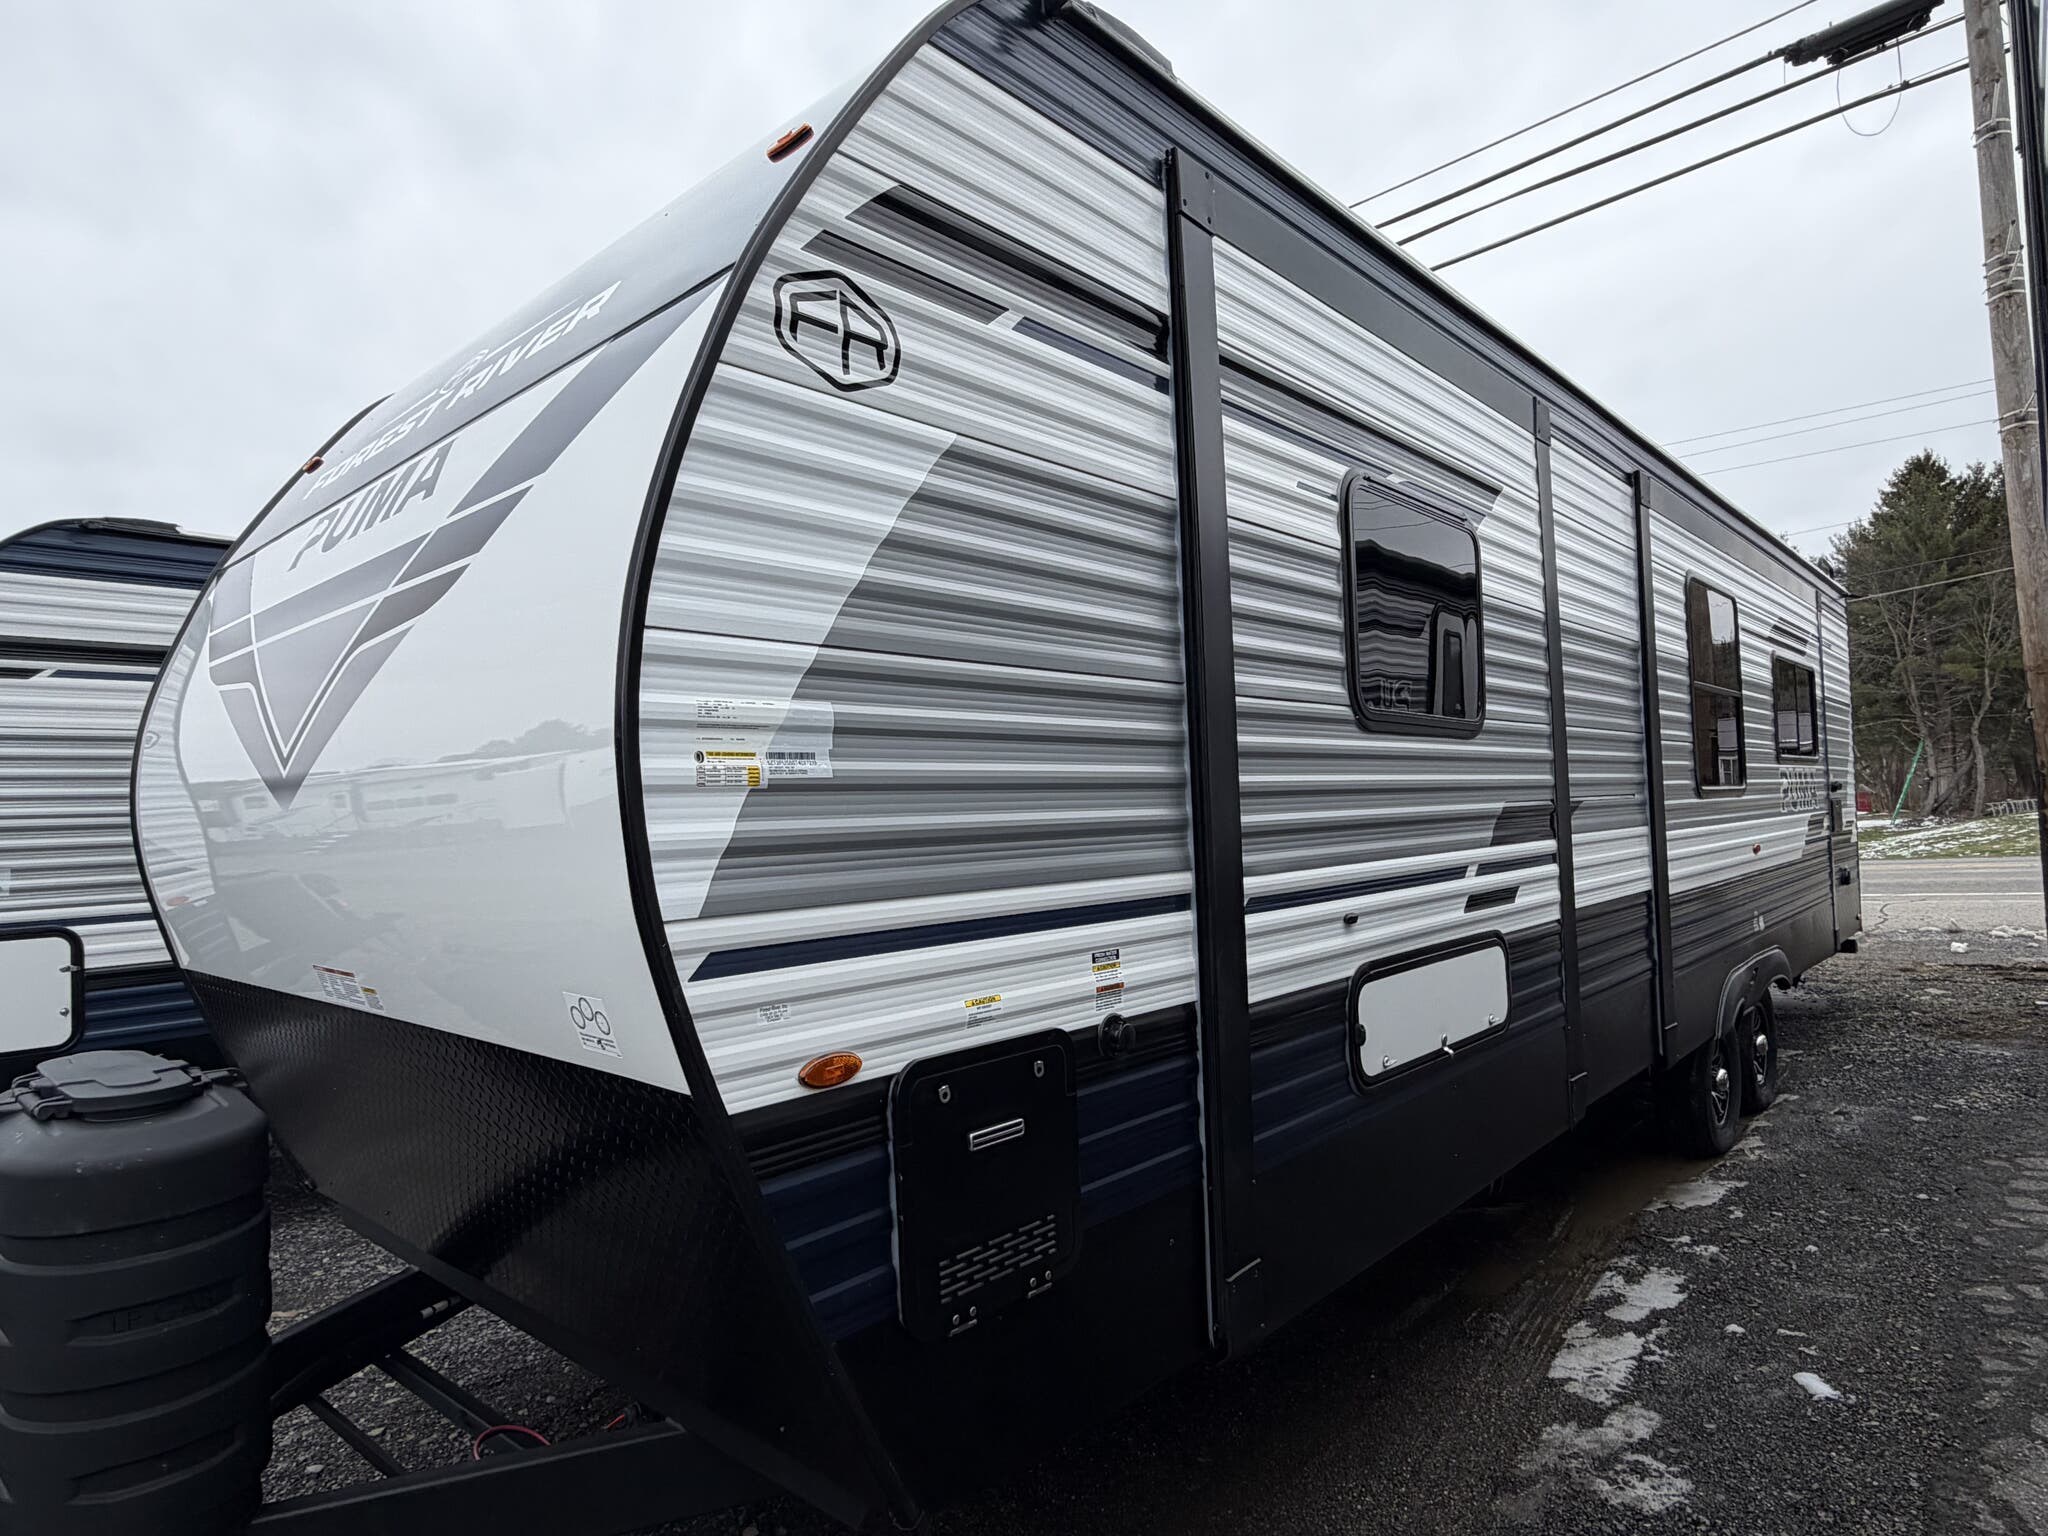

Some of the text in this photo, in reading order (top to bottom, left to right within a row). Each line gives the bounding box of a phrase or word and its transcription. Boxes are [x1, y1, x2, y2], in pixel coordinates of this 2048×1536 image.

[303, 281, 622, 500] FOREST RIVER
[287, 436, 458, 572] PUMA
[1779, 767, 1820, 813] PUMA
